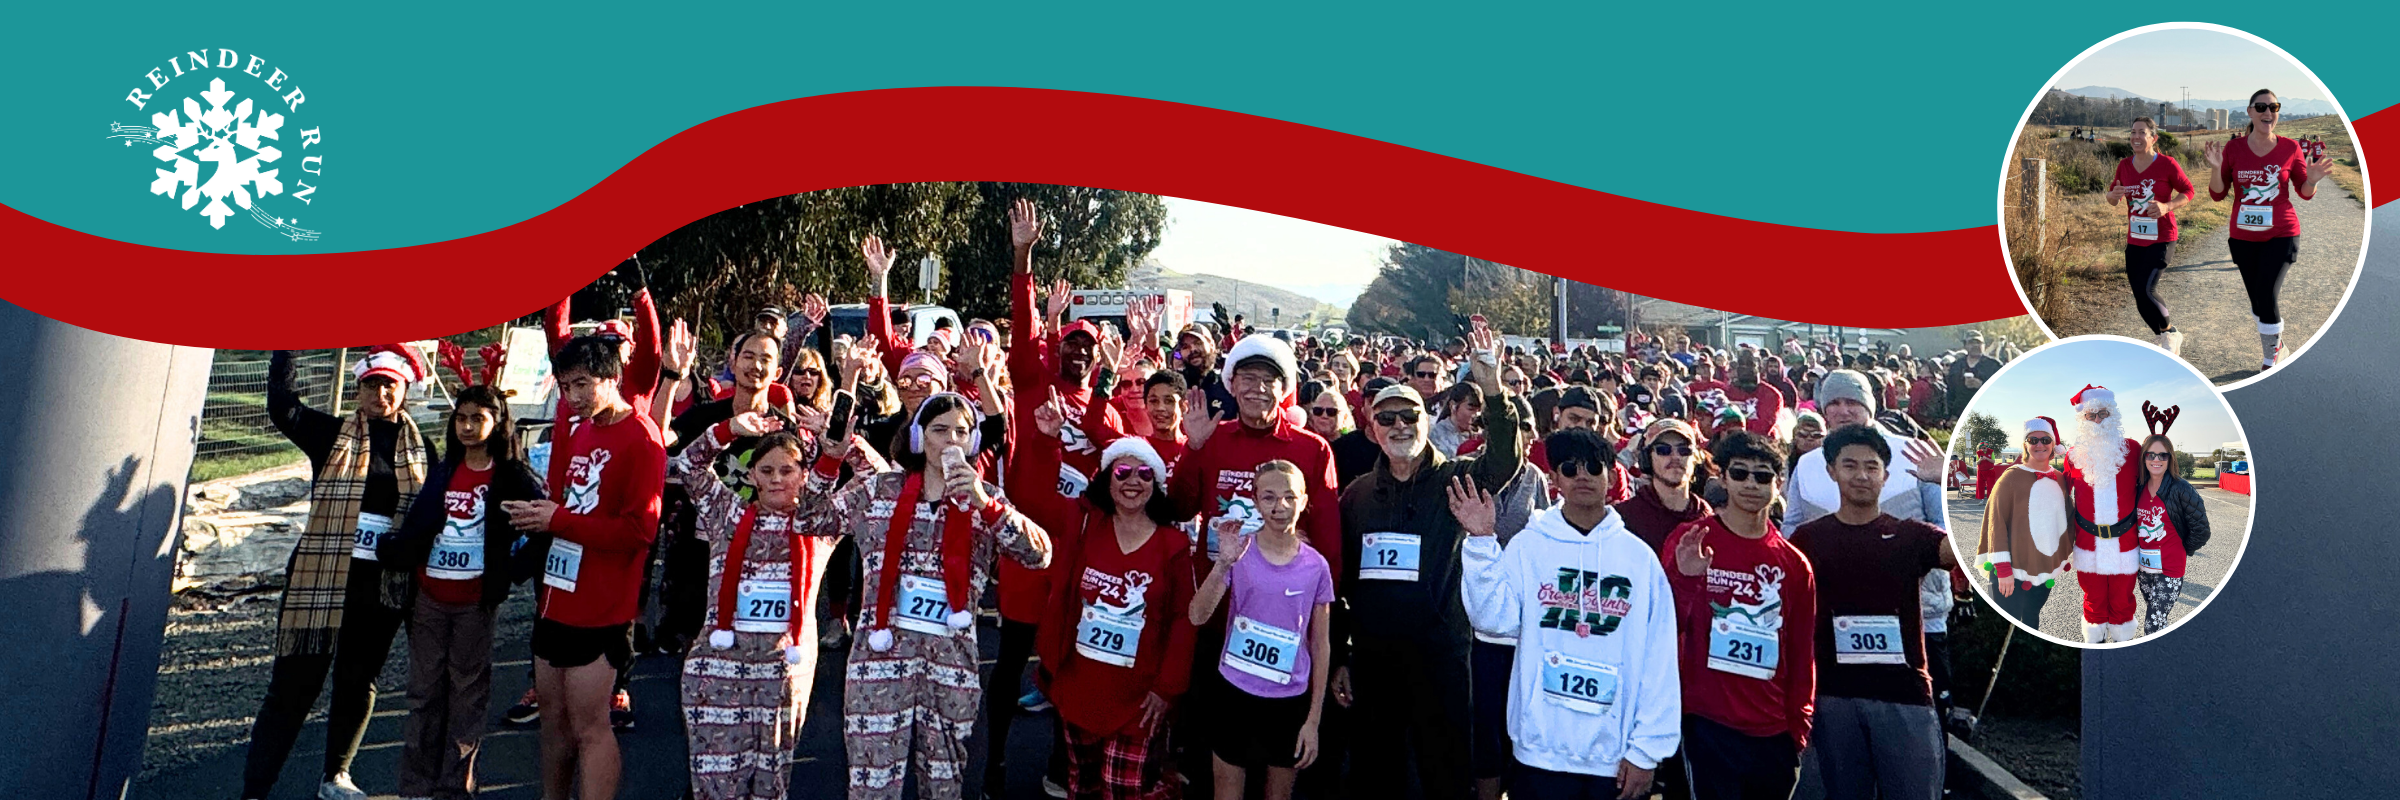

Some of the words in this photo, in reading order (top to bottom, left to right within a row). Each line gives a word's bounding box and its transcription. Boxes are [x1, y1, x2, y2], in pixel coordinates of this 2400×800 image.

[2137, 224, 2148, 234] 17
[2244, 214, 2264, 225] 329
[438, 550, 470, 568] 380
[547, 554, 568, 575] 511
[1377, 548, 1399, 566] 12
[1706, 567, 1756, 582] REINDEER
[1706, 576, 1729, 586] RUN
[1537, 581, 1579, 602] Cross
[1582, 586, 1632, 613] Country
[749, 599, 786, 618] 276
[910, 596, 949, 620] 277
[1088, 626, 1125, 651] 279
[1850, 632, 1888, 650] 303
[1242, 638, 1280, 665] 306
[1727, 639, 1763, 663] 231
[1560, 672, 1599, 698] 126
